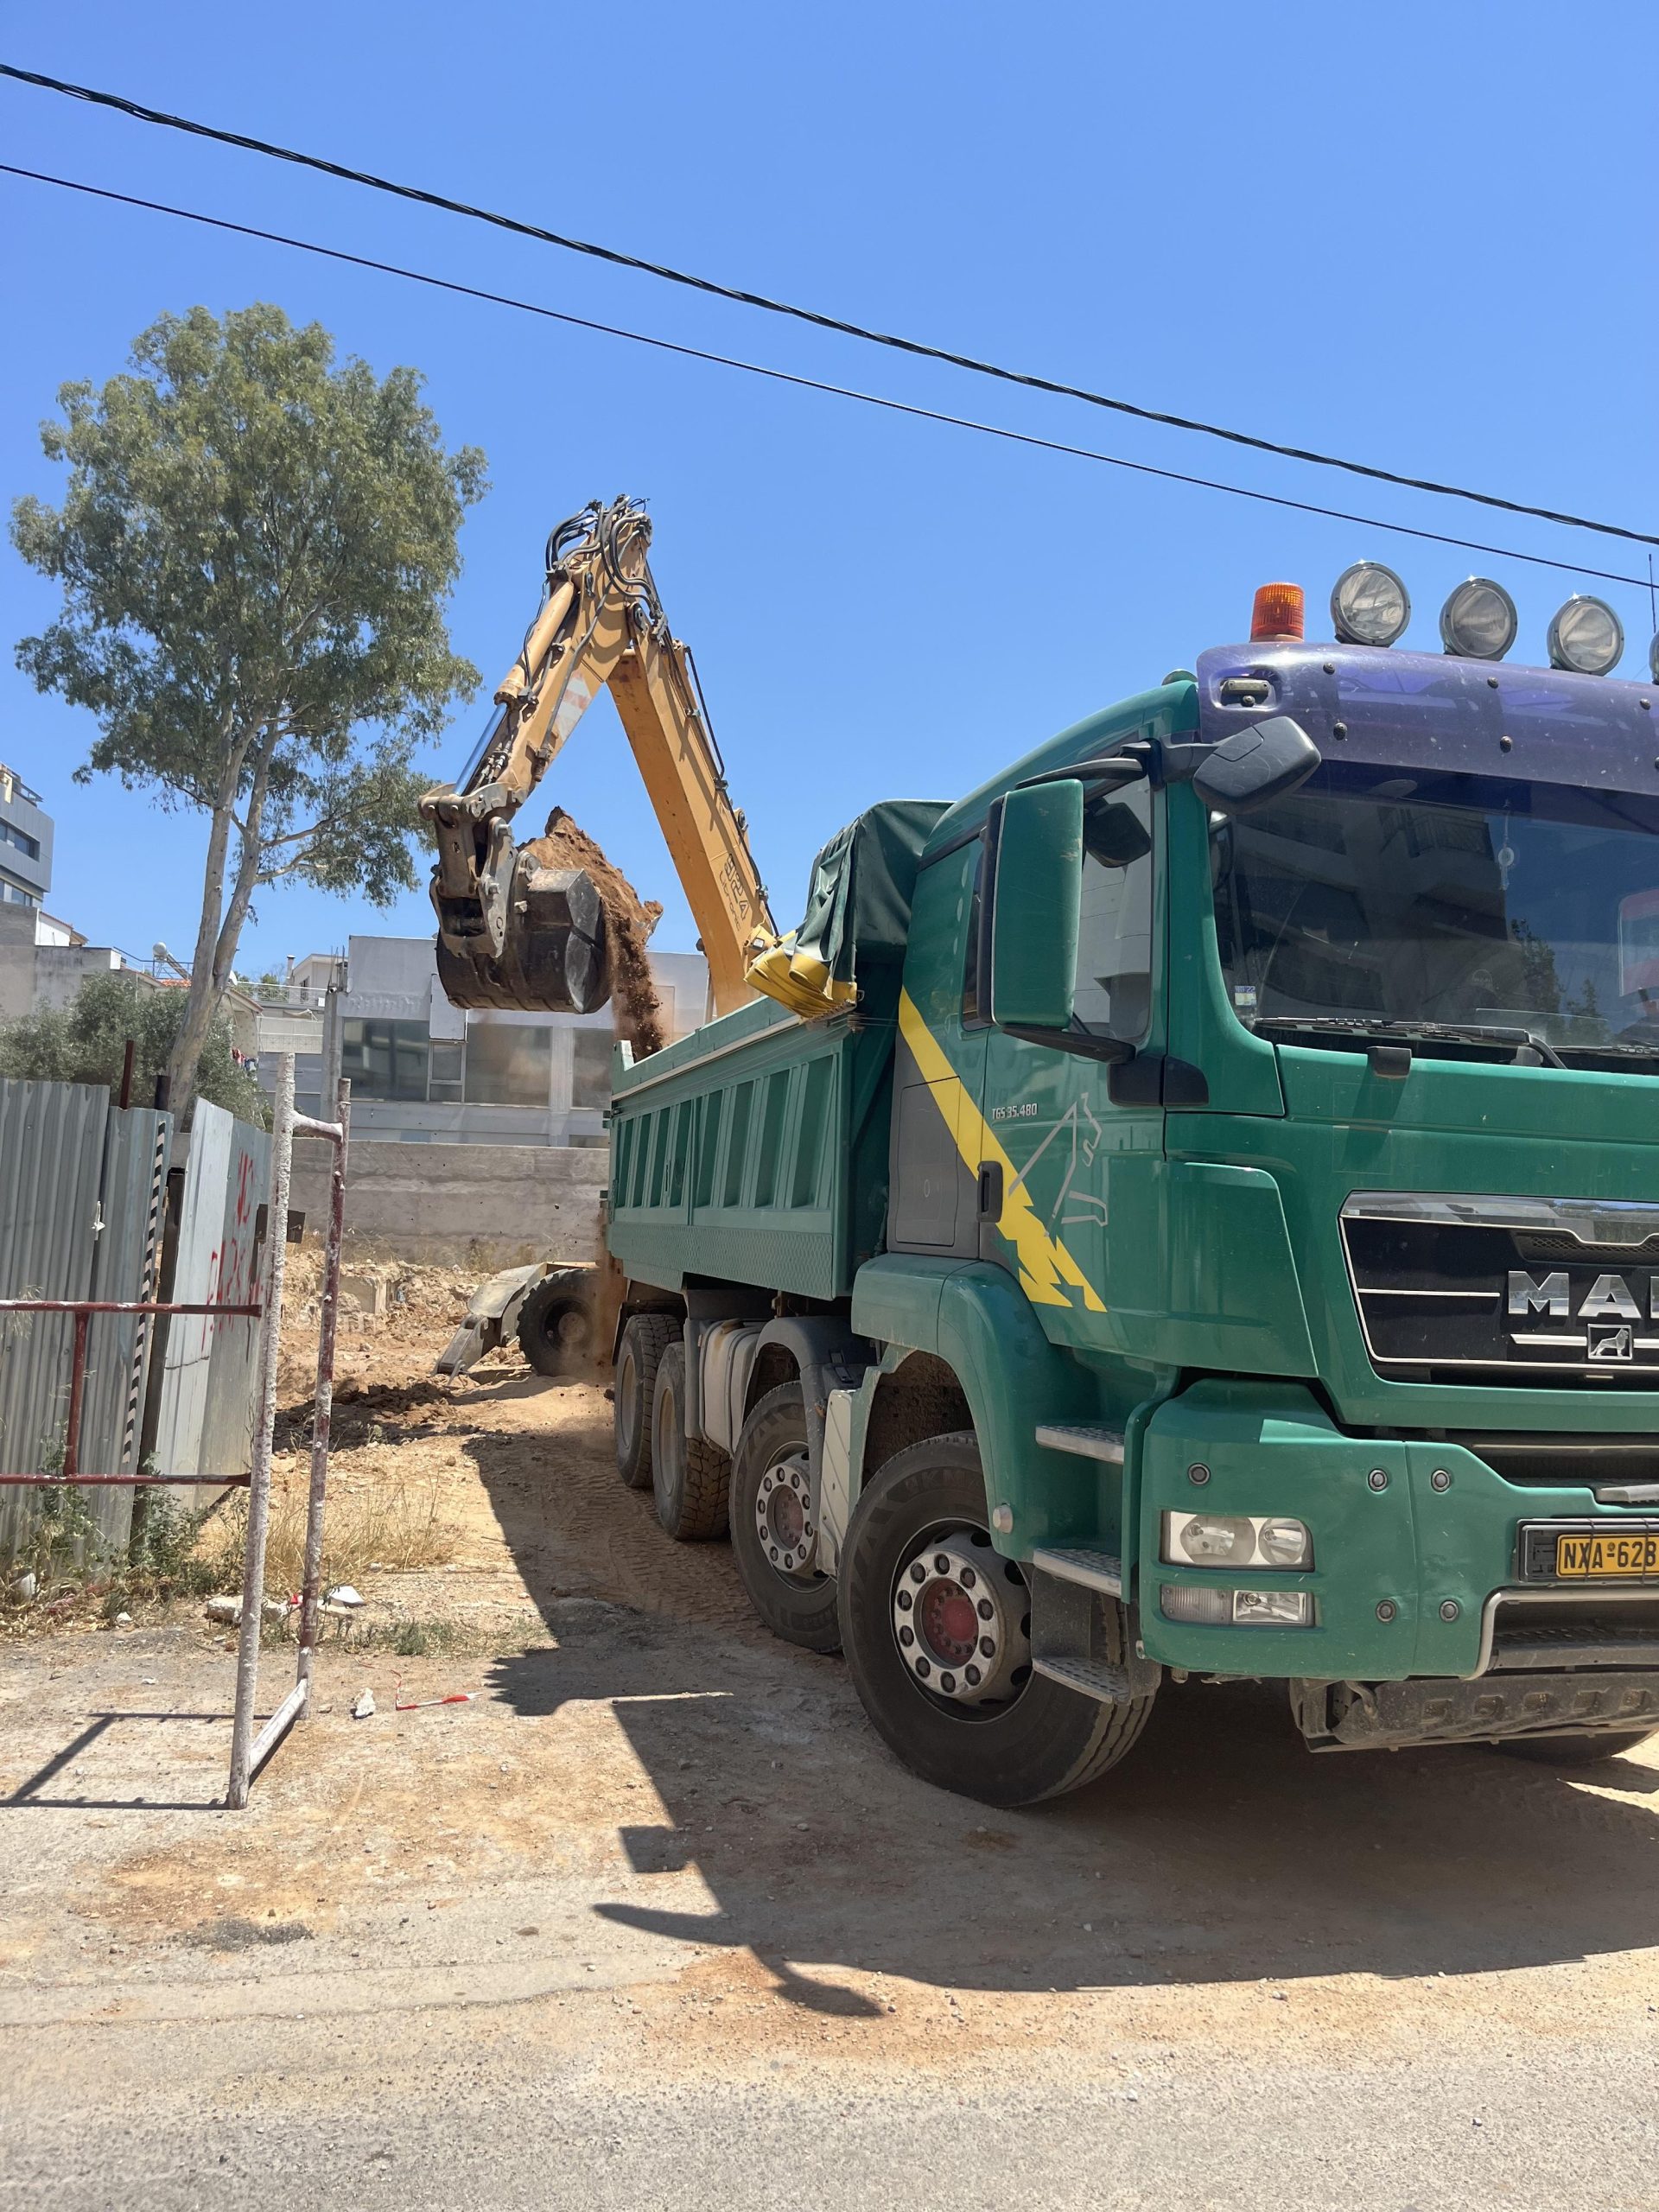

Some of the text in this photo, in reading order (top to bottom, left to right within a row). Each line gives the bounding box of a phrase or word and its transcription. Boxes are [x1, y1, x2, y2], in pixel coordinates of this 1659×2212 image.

[991, 1103, 1038, 1120] TGS 35.480
[1508, 1270, 1659, 1319] MA
